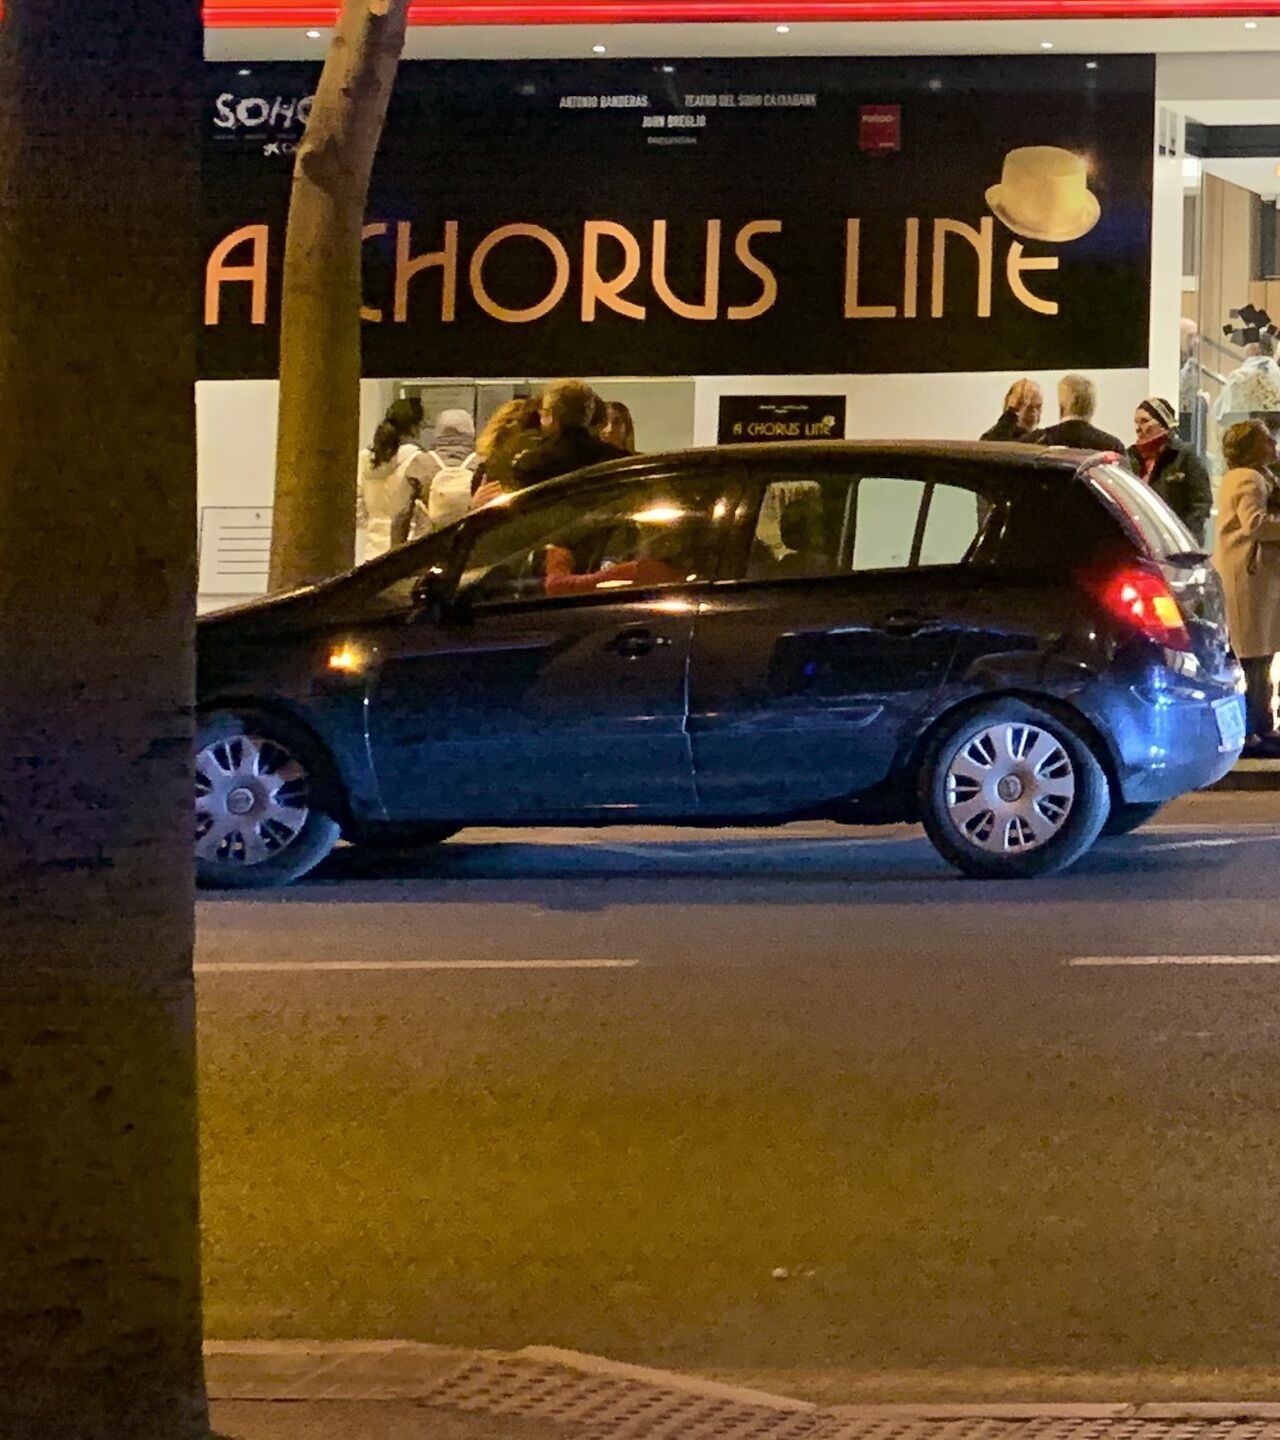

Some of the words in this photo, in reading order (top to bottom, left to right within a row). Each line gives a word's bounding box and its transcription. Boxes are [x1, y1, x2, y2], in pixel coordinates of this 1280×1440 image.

[204, 224, 269, 325] A
[360, 218, 783, 322] HORUS
[844, 216, 1060, 319] LINE
